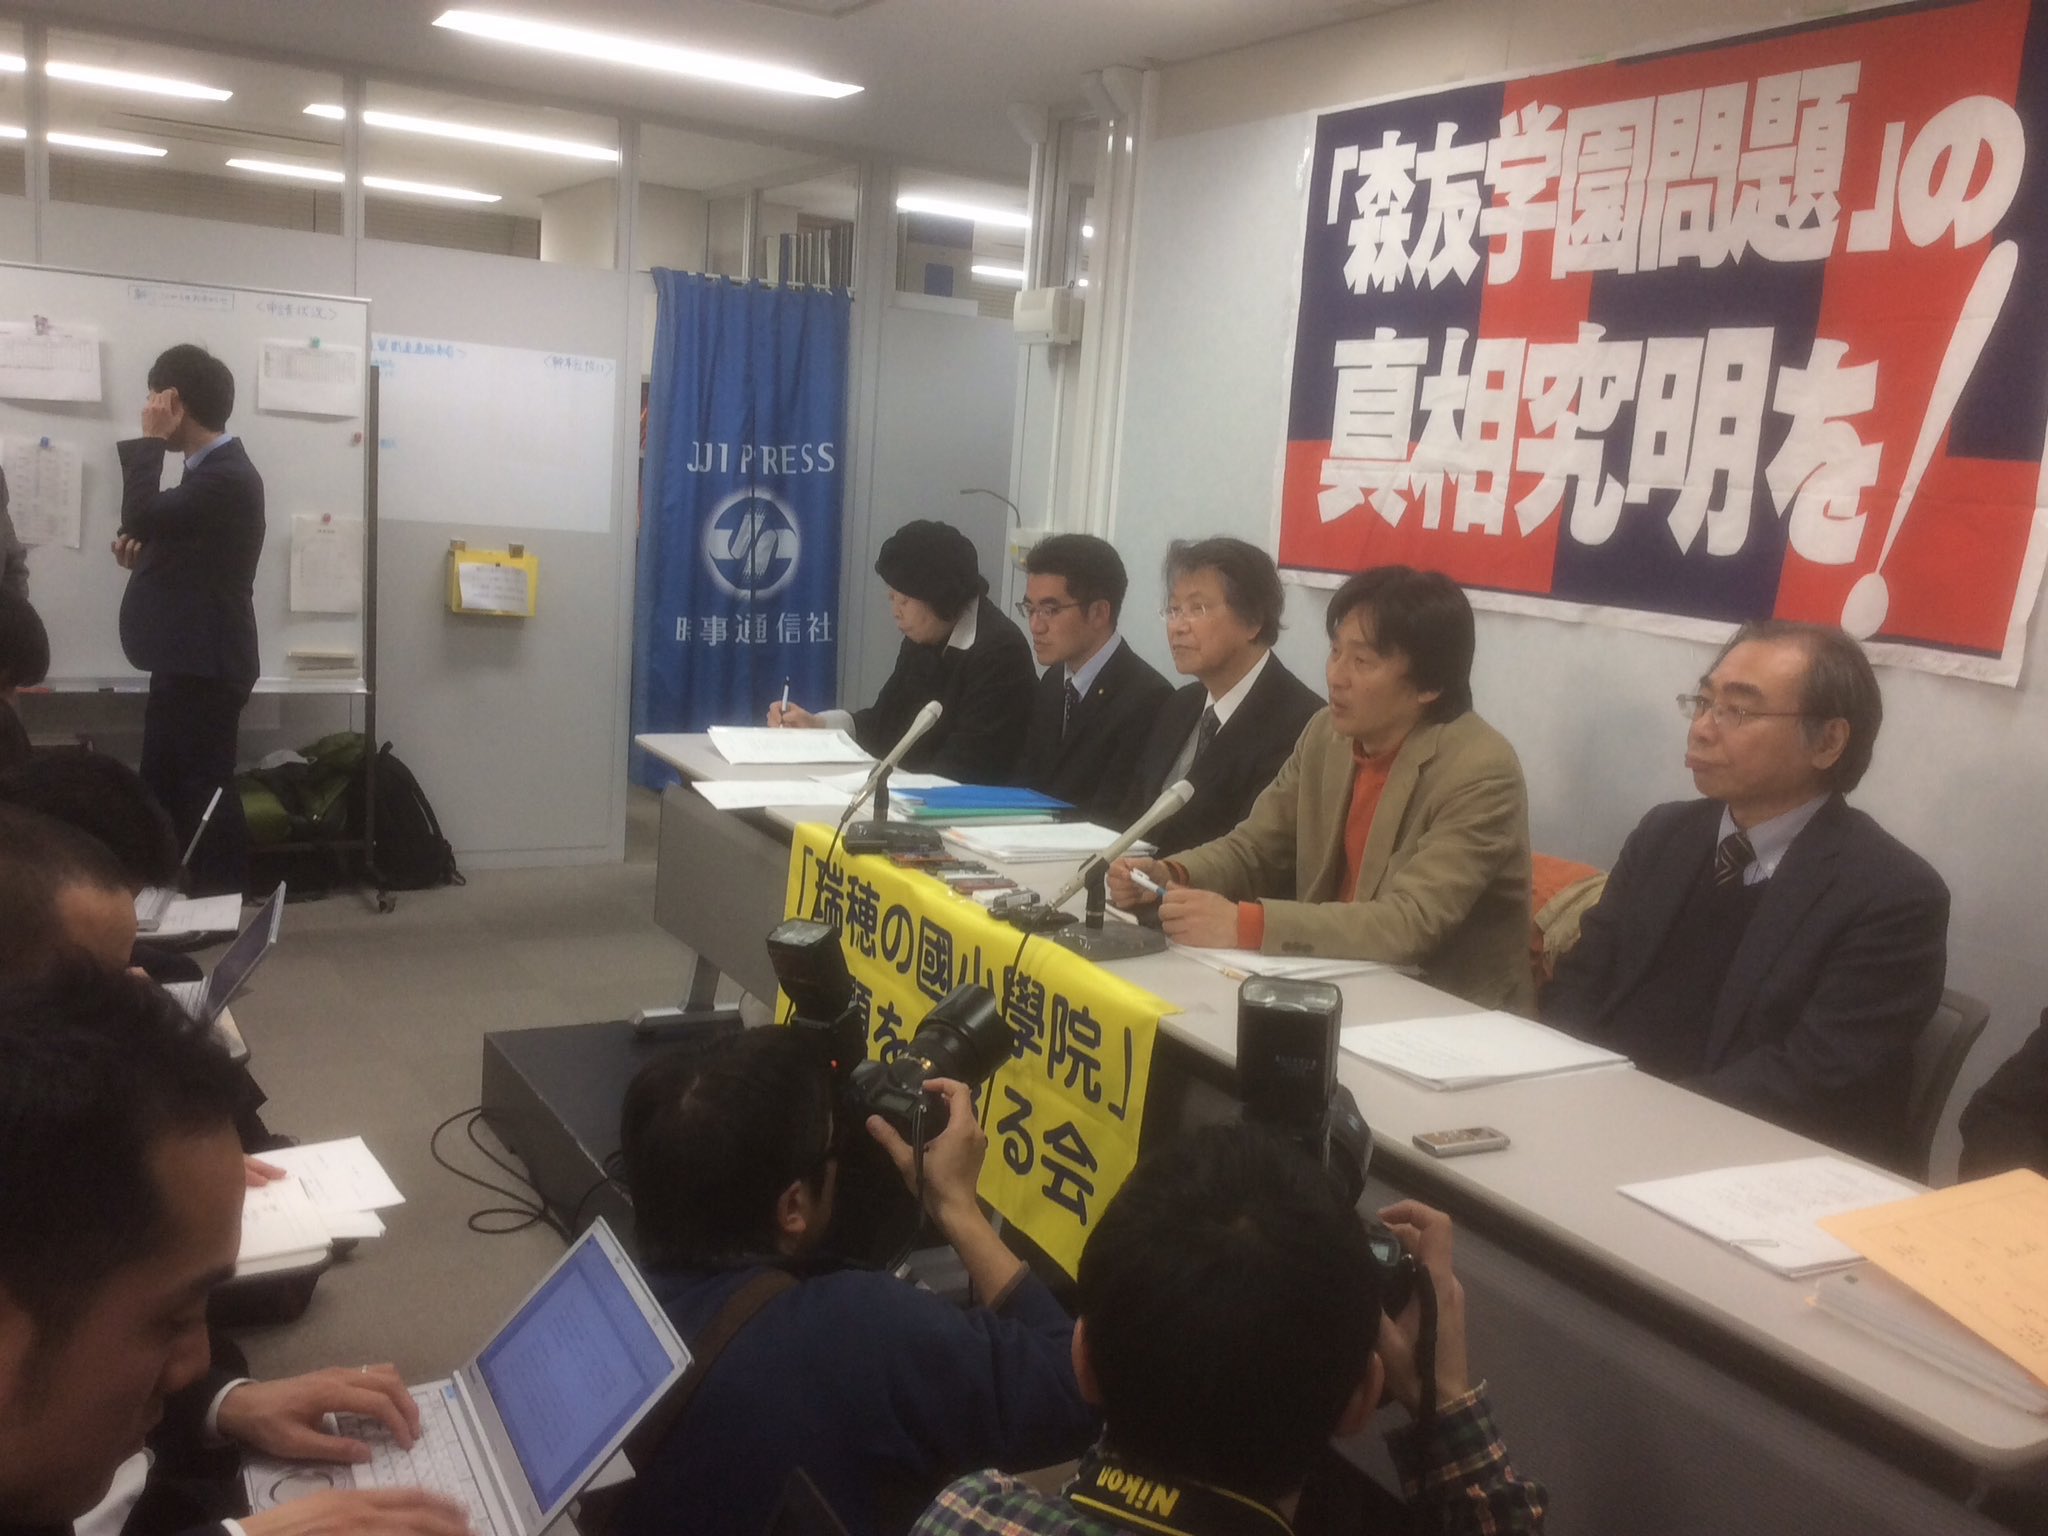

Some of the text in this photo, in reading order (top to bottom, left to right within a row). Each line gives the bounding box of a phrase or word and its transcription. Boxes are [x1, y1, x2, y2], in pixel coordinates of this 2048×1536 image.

[1327, 61, 2025, 294] 「森友学園問題」の
[740, 442, 835, 475] PRESS
[1096, 1464, 1181, 1519] Nikon
